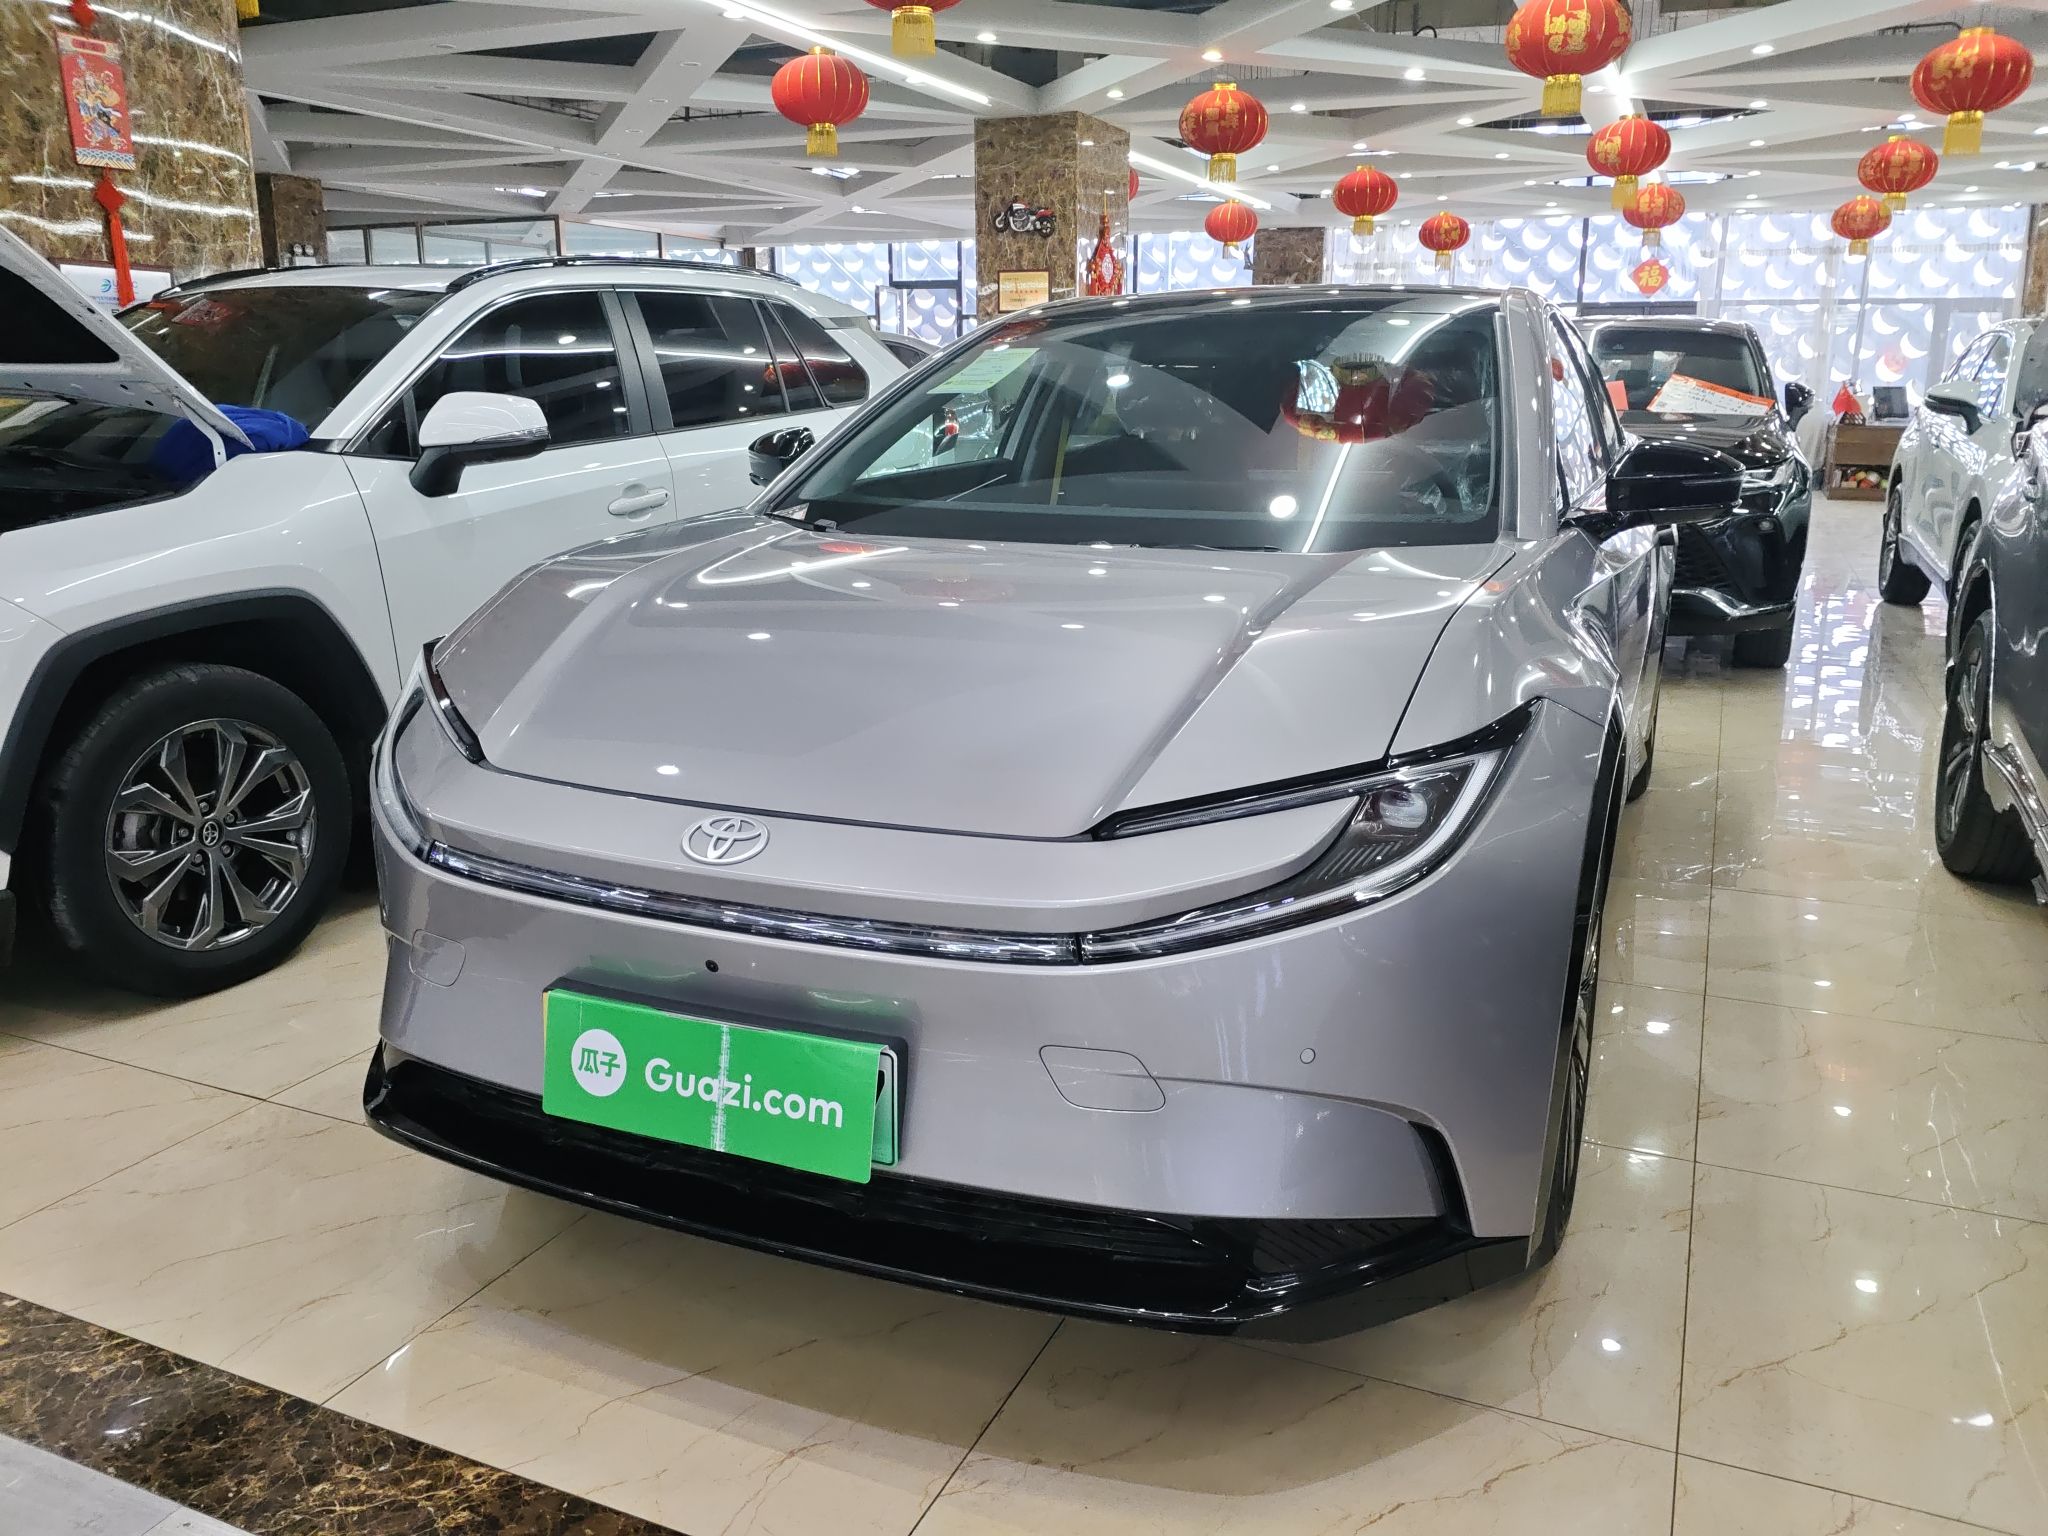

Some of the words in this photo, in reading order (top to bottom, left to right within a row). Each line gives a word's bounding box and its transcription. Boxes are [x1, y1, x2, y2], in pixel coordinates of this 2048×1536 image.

[1638, 264, 1663, 288] 福
[578, 1047, 621, 1078] 瓜子
[644, 1057, 844, 1128] Guazi.com
